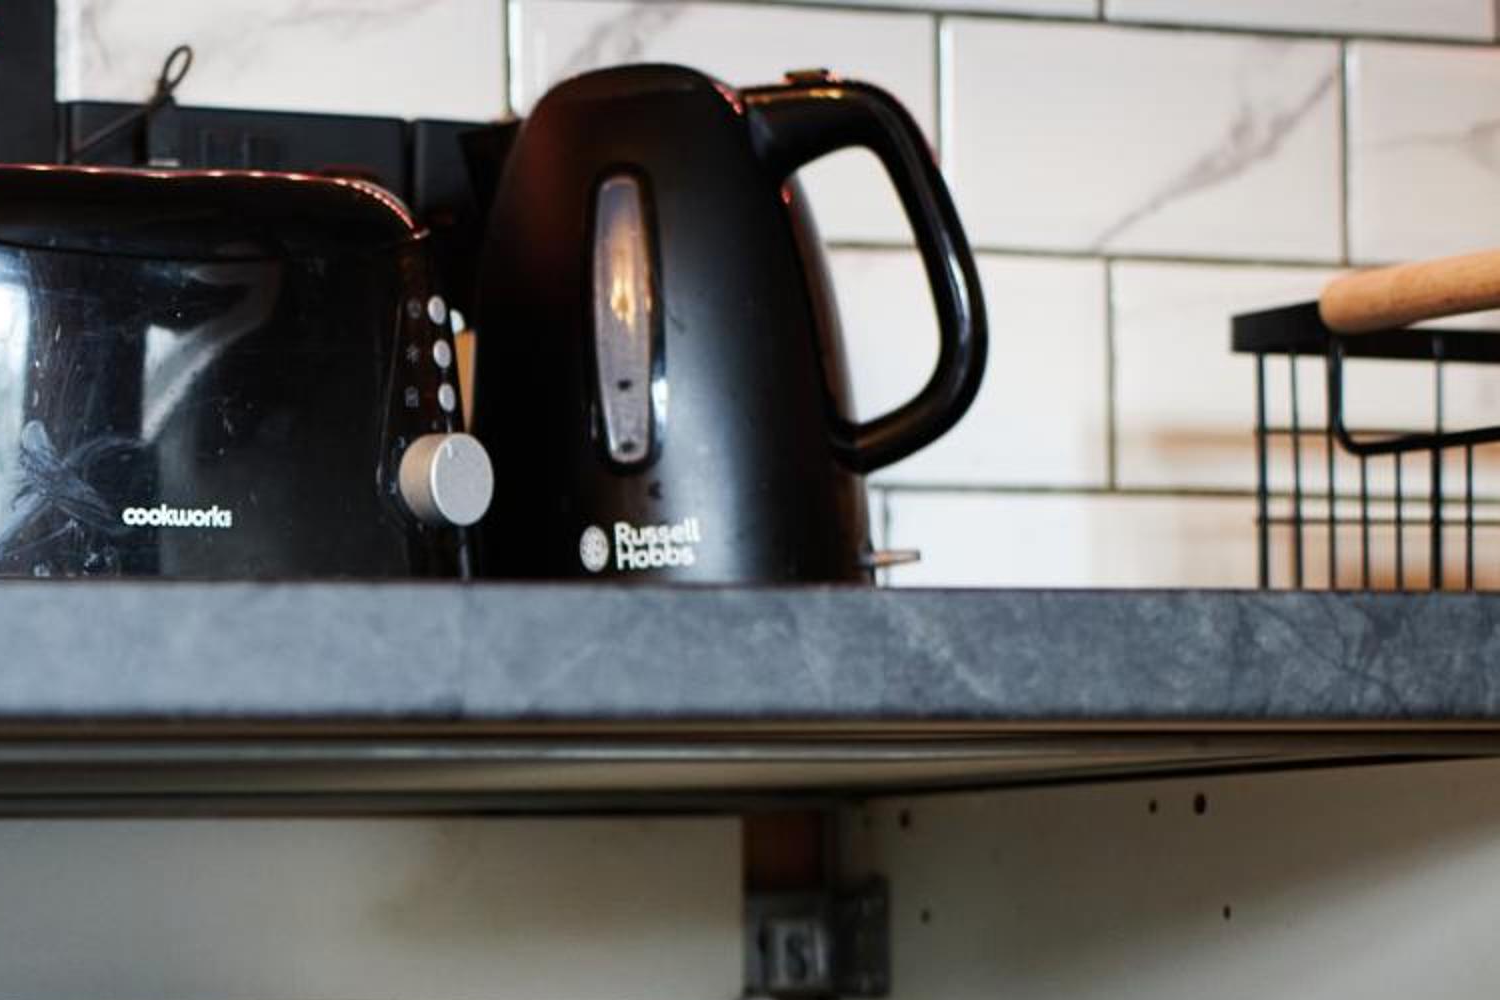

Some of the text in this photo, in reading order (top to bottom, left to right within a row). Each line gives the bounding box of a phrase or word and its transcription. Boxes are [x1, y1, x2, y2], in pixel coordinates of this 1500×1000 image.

[122, 503, 232, 528] cookworks
[614, 517, 701, 545] Russell
[616, 544, 695, 570] Hobbs
